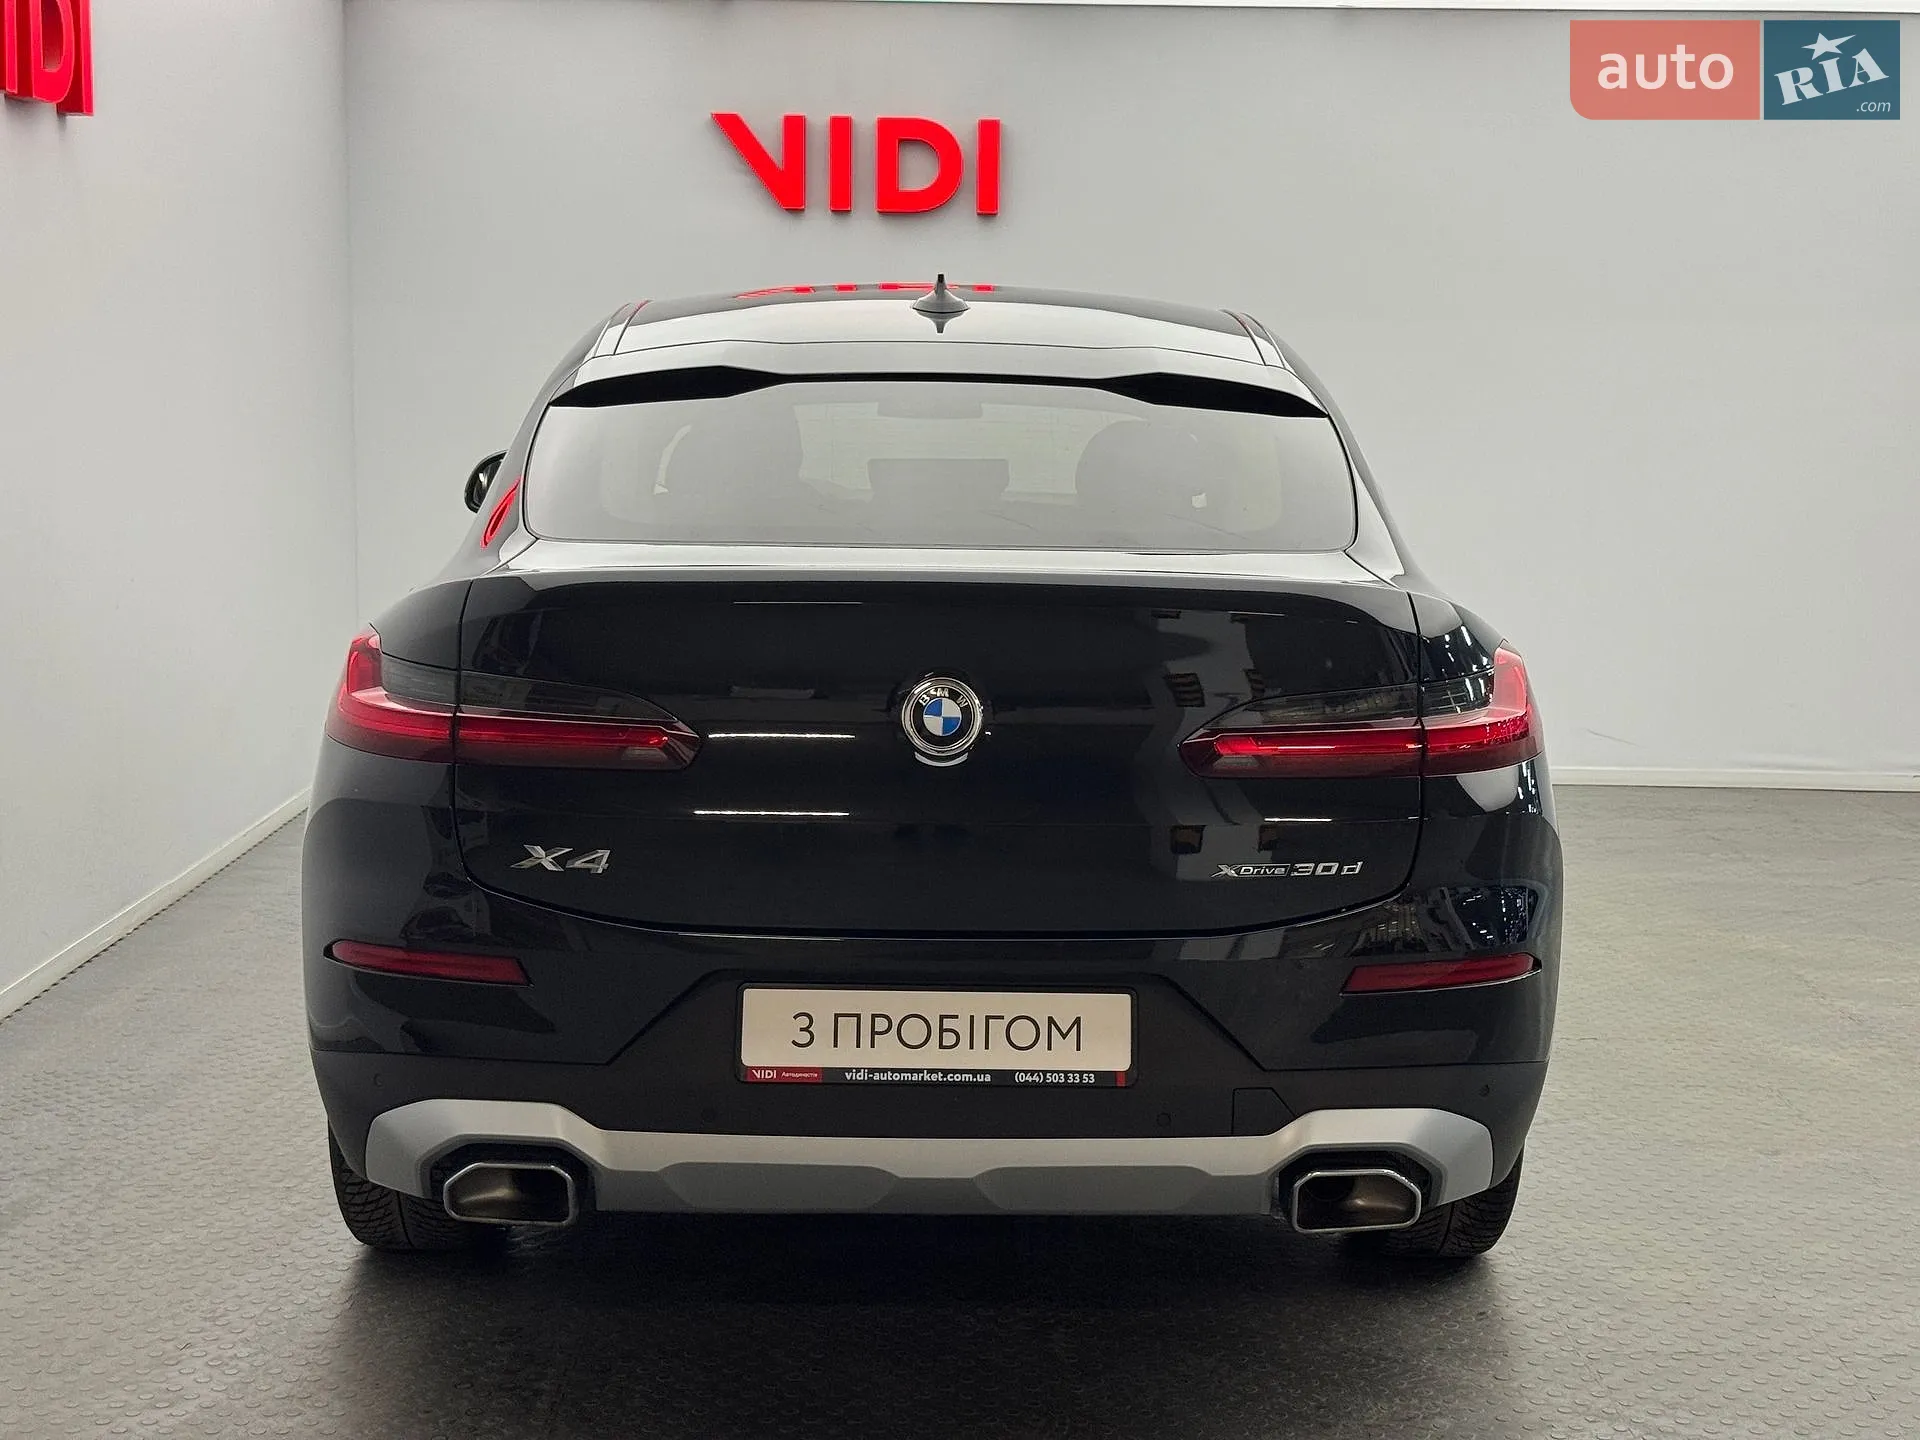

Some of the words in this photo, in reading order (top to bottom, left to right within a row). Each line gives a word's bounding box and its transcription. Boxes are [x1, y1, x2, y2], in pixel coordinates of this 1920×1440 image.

[710, 112, 1001, 215] VIDI
[918, 687, 969, 707] BMW
[510, 844, 611, 874] X4
[832, 1012, 1082, 1052] ПРОБІГОМ
[752, 1069, 777, 1079] VIDI
[845, 1069, 992, 1083] vidi-automarket.com.ua
[1014, 1071, 1044, 1084] (044)
[1045, 1073, 1066, 1084] 503
[1067, 1073, 1081, 1084] 33
[1082, 1073, 1095, 1084] 53
